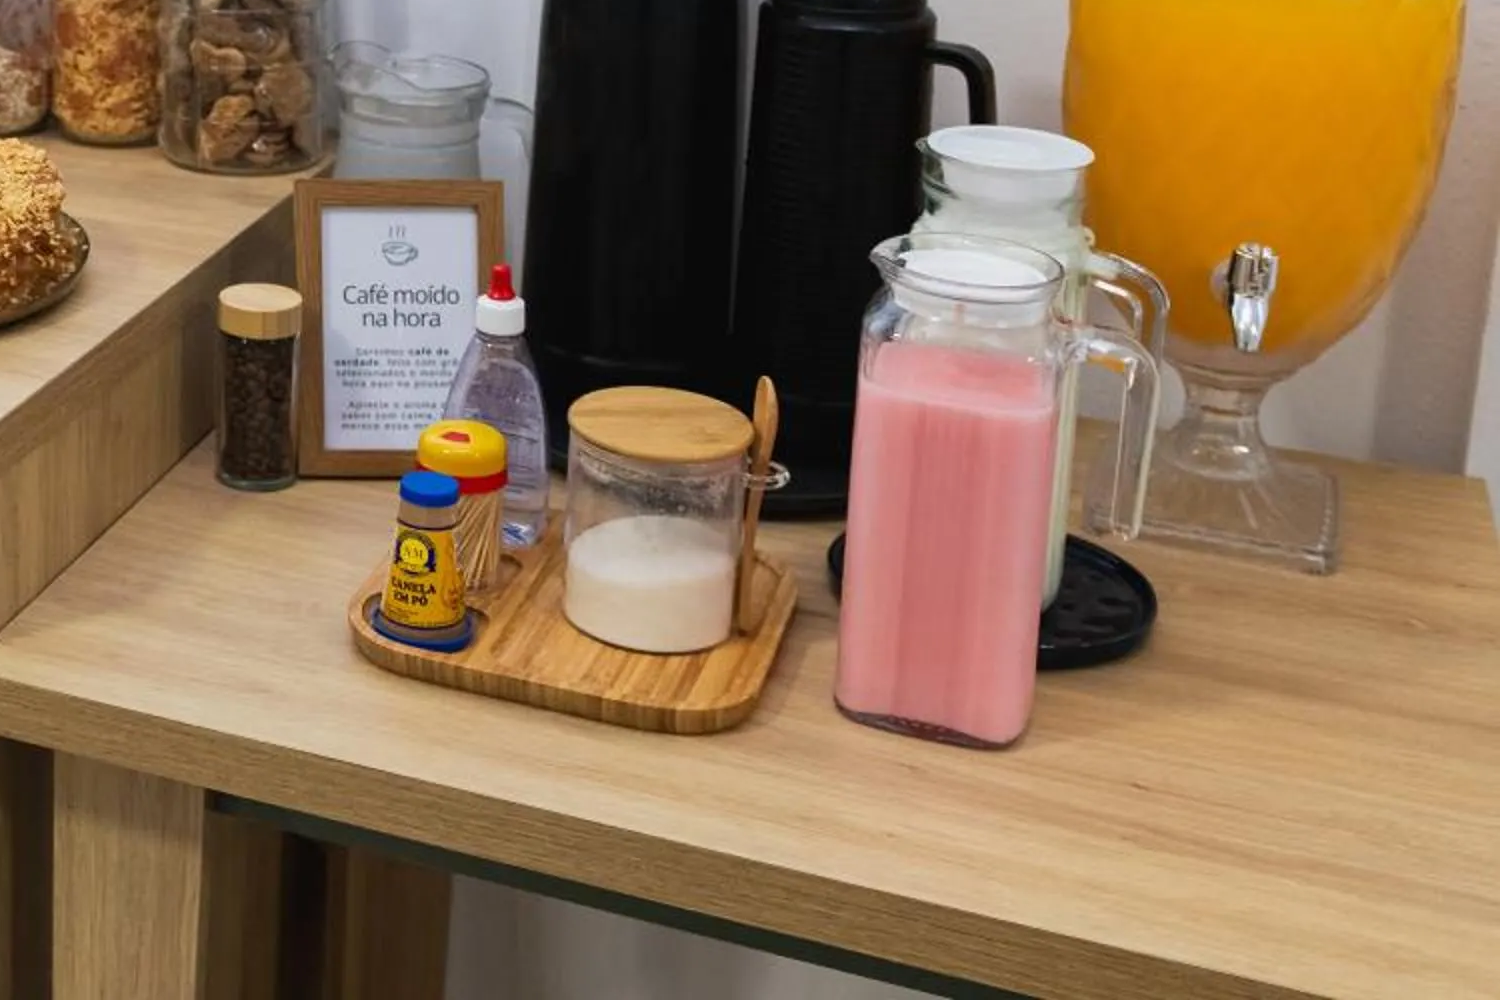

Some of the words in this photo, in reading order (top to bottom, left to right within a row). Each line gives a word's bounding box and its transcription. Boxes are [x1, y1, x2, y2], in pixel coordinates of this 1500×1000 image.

[343, 283, 389, 305] Café
[393, 284, 460, 305] moído
[362, 311, 388, 328] na
[393, 308, 441, 328] hora
[391, 576, 437, 595] CANELA
